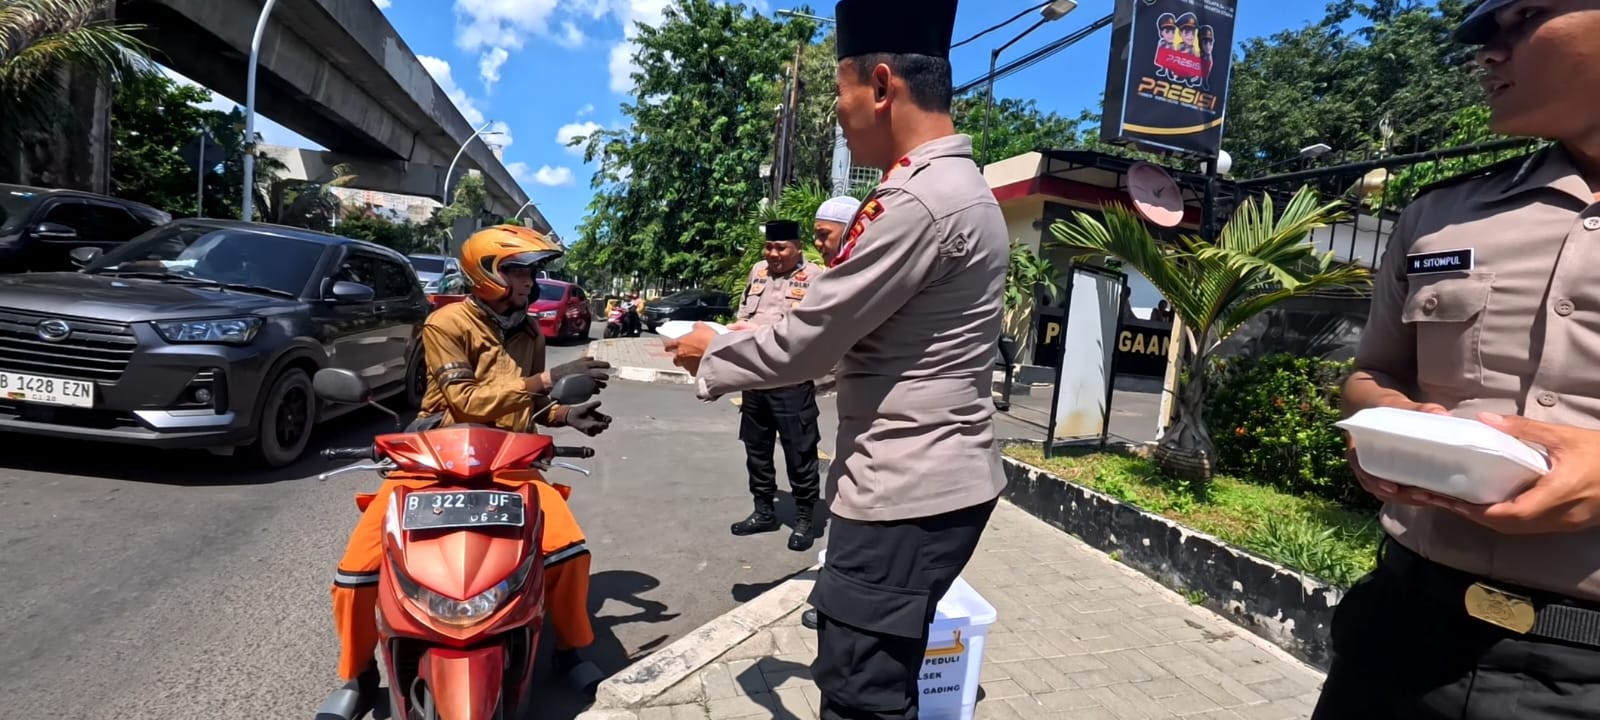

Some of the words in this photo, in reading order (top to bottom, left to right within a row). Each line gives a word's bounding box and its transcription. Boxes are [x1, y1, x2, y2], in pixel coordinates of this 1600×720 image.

[1138, 76, 1217, 110] PRESISI
[1423, 255, 1461, 268] SITOMPUL
[0, 373, 8, 388] B
[17, 376, 53, 393] 1428
[63, 381, 90, 398] EZN
[408, 496, 419, 510] B
[925, 656, 960, 665] PEDULI
[923, 684, 960, 695] GADING
